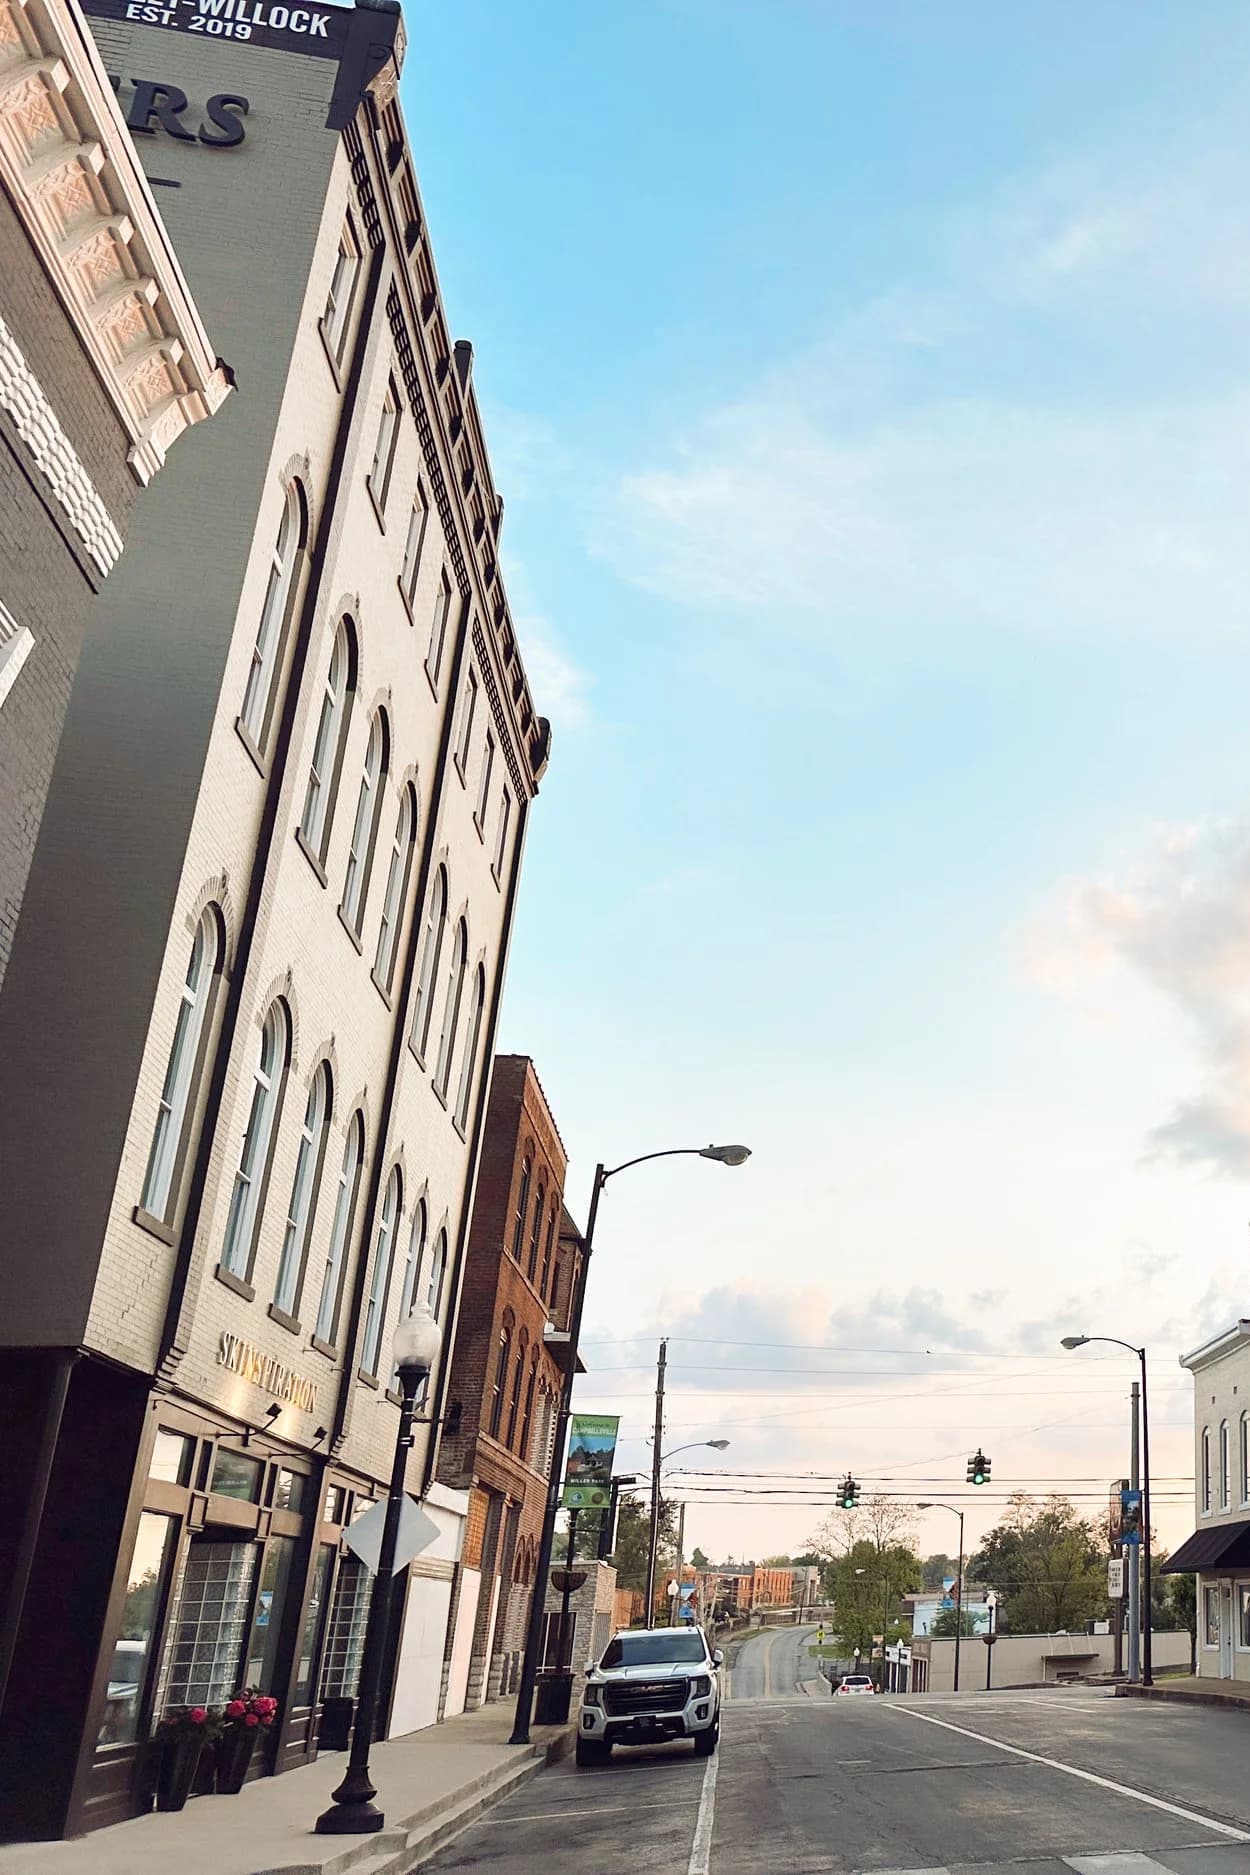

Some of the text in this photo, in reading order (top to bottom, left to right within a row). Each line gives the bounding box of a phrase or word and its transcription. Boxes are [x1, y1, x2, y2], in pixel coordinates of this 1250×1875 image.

[126, 4, 252, 40] EST. 2019
[108, 75, 249, 147] RS
[217, 1331, 318, 1413] SKINSPIRATION
